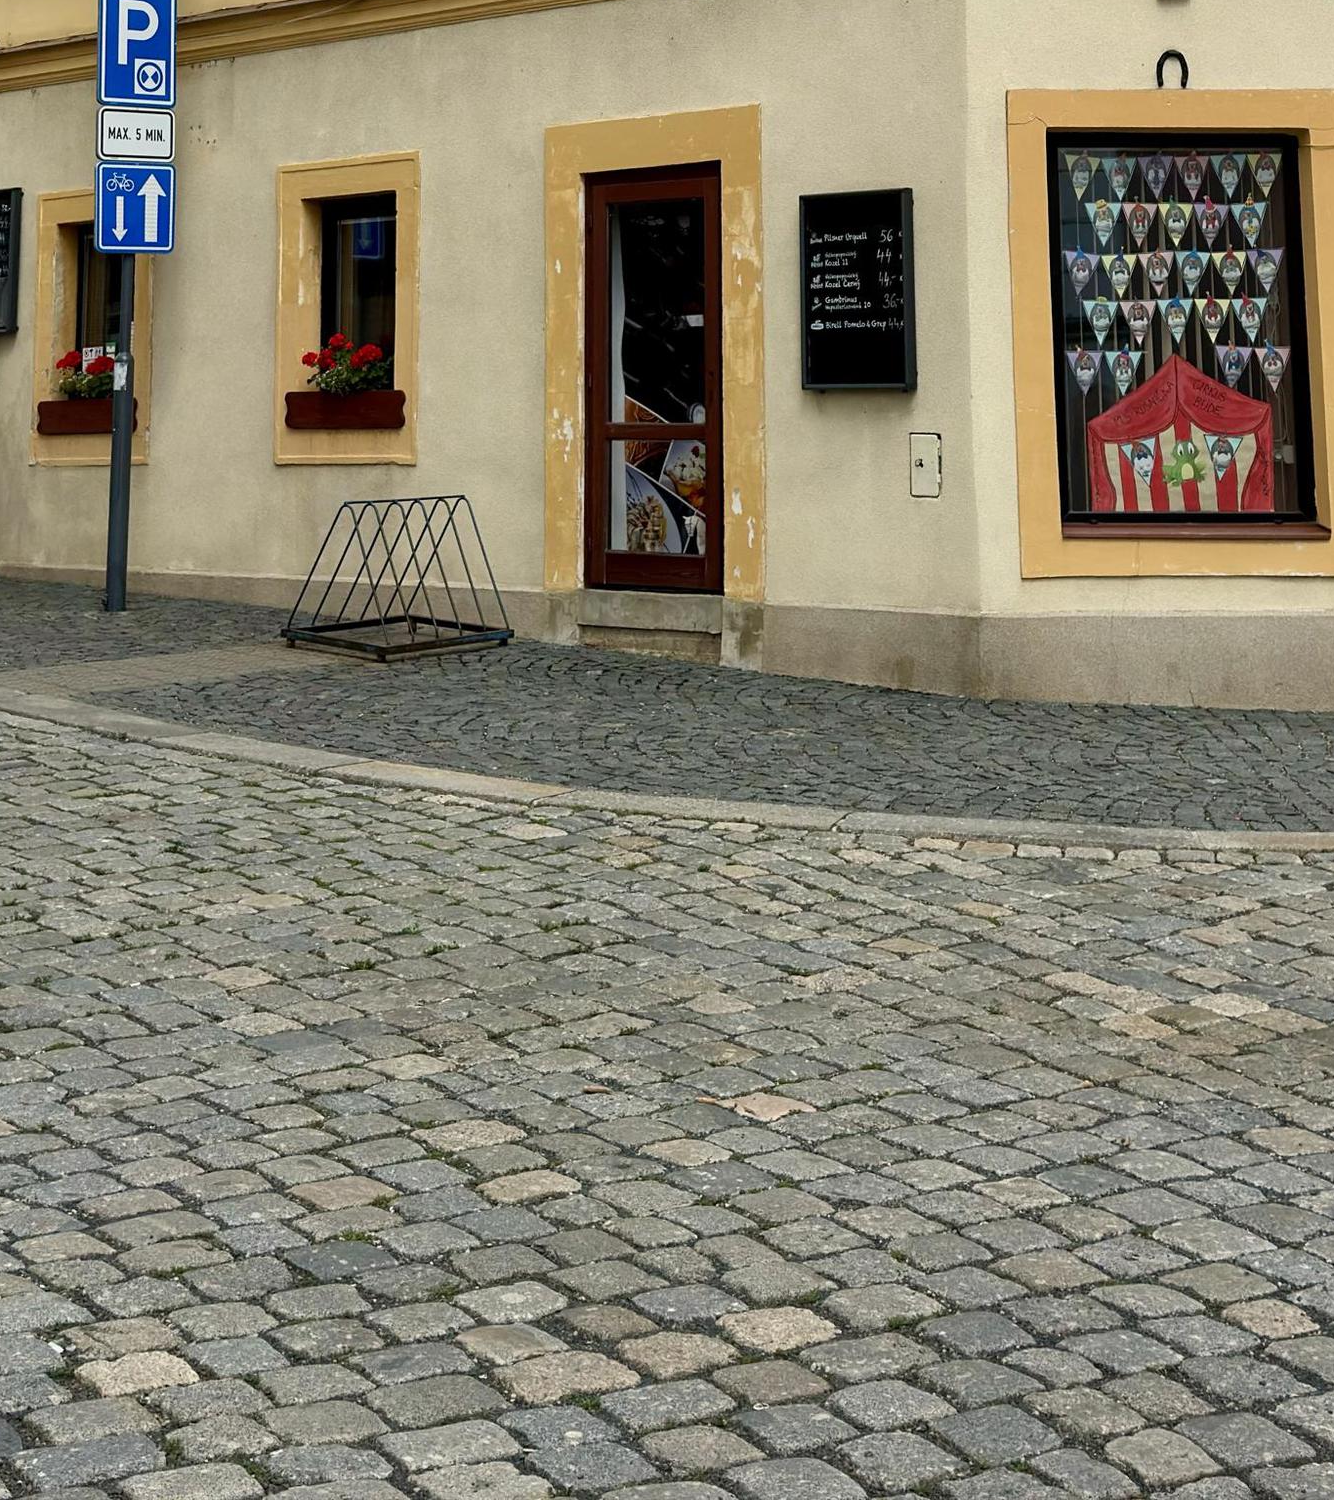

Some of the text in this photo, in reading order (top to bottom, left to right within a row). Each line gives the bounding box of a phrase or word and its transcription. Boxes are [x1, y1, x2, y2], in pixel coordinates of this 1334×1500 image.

[107, 126, 166, 142] MAX. 5 MIN.
